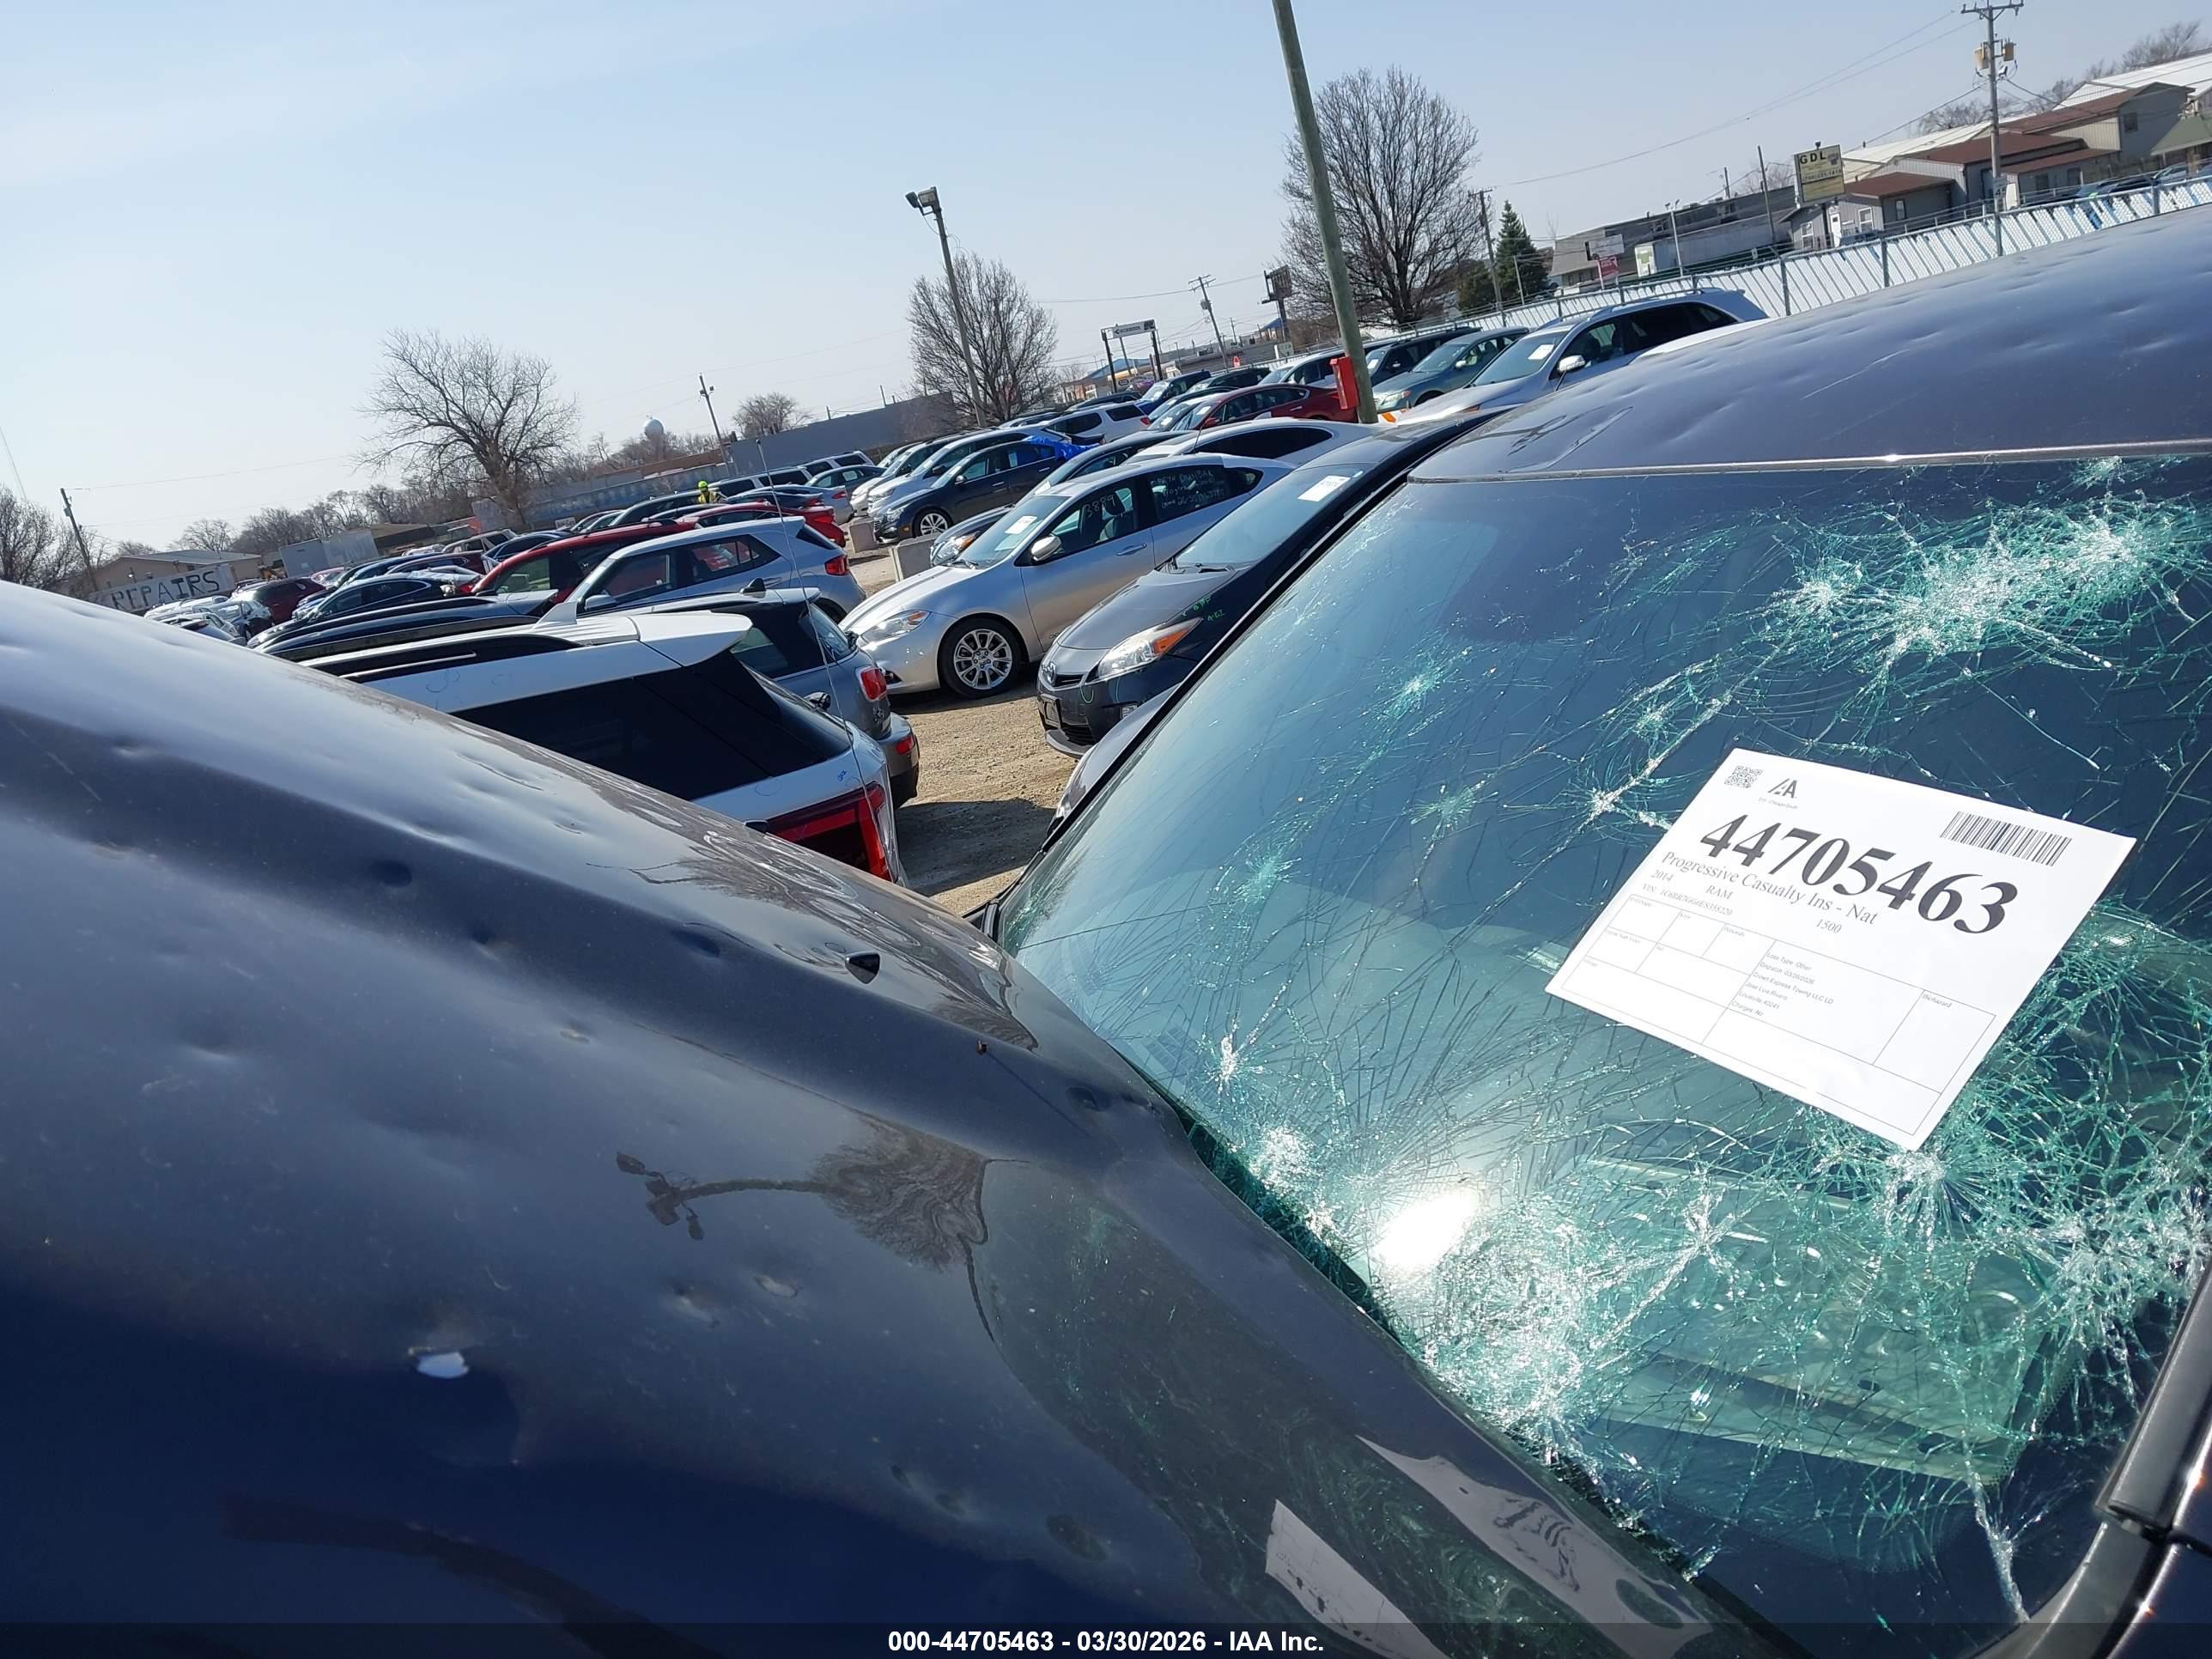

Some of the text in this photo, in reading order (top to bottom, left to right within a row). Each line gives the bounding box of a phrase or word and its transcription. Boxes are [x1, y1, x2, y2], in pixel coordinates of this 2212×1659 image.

[112, 570, 220, 610] REPAIRS
[1650, 868, 1843, 934] 2014 RAM 1500
[1662, 851, 1740, 884] Progressive
[1741, 872, 1806, 905] Casualty
[1808, 891, 1834, 912] Ins
[1845, 902, 1879, 926] Nat
[1700, 813, 2018, 934] 44705463
